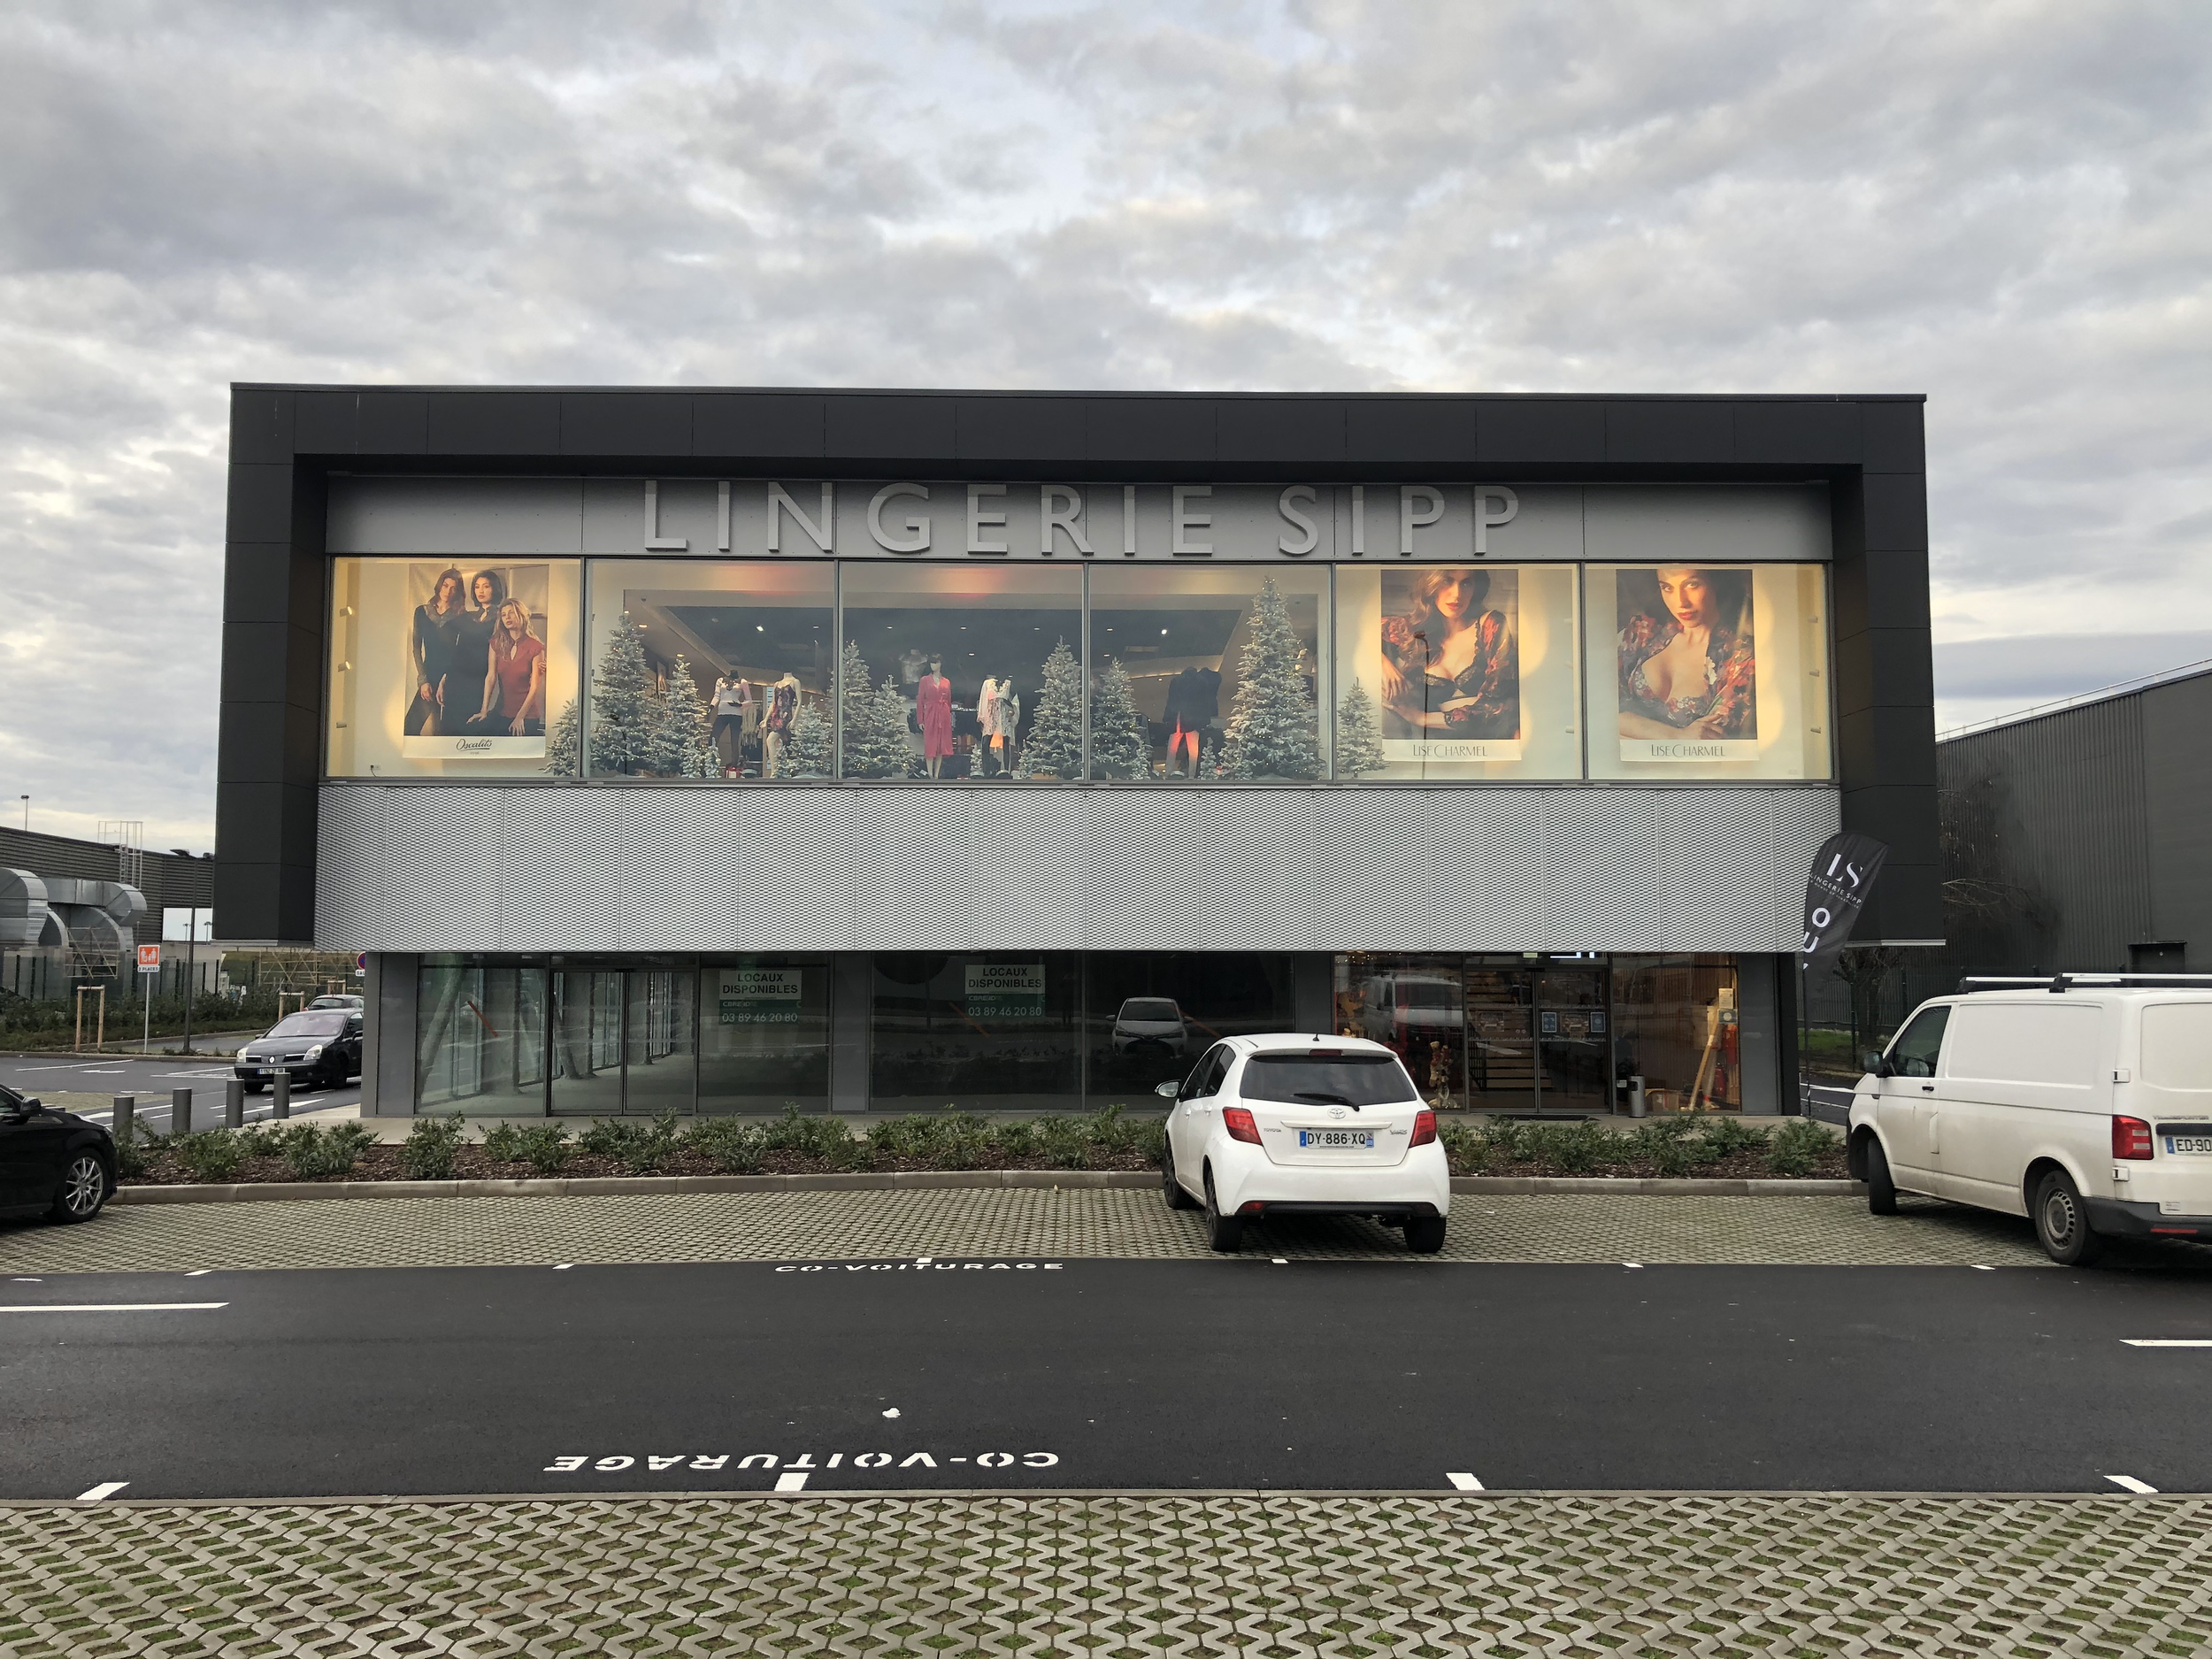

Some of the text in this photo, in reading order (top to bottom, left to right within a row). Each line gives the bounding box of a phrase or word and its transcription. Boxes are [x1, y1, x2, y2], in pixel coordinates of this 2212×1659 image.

[645, 480, 1519, 557] LINGERIE SIPP
[456, 738, 493, 751] Oscalito
[1413, 744, 1488, 757] LISE CHARMEL
[1651, 744, 1726, 757] LISE CHARMEL
[1809, 872, 1845, 895] LINGERIE
[1846, 893, 1863, 904] SIPP
[737, 973, 784, 982] LOCAUX
[982, 967, 1028, 977] LOCAUX
[968, 979, 1042, 988] DISPONIBLES
[722, 985, 798, 994] DISPONIBLES
[968, 1007, 1042, 1017] 03 89 46 20 80
[722, 1013, 798, 1023] 03 89 46 20 80
[1307, 1133, 1366, 1145] DY-886-XQ
[774, 1263, 1064, 1272] CO-VOITURAGE
[543, 1451, 1060, 1471] CO-VOITURAGE
